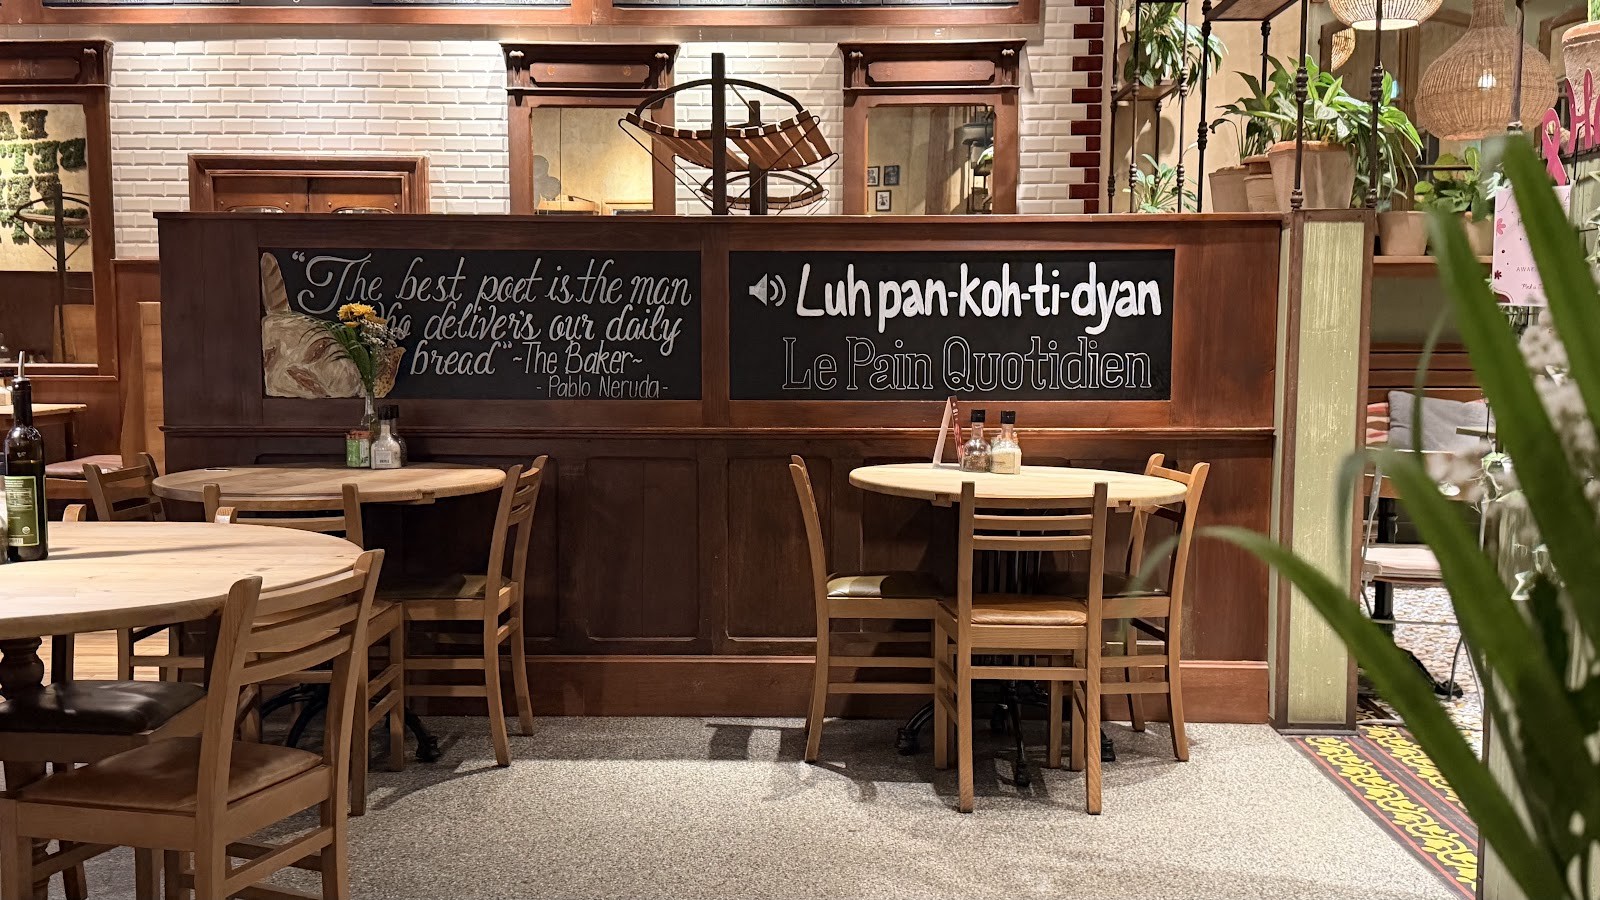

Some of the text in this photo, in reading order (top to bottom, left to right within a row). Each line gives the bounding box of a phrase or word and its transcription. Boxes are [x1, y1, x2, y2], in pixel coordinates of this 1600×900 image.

[395, 257, 466, 302] best
[473, 258, 542, 313] poet
[545, 266, 574, 304] is
[576, 259, 623, 304] the
[630, 275, 692, 306] man
[796, 261, 1162, 335] Luh pan-koh-ti-dyan
[549, 313, 595, 341] our
[606, 304, 683, 356] daily
[782, 335, 1152, 392] Le Pain Quotidien
